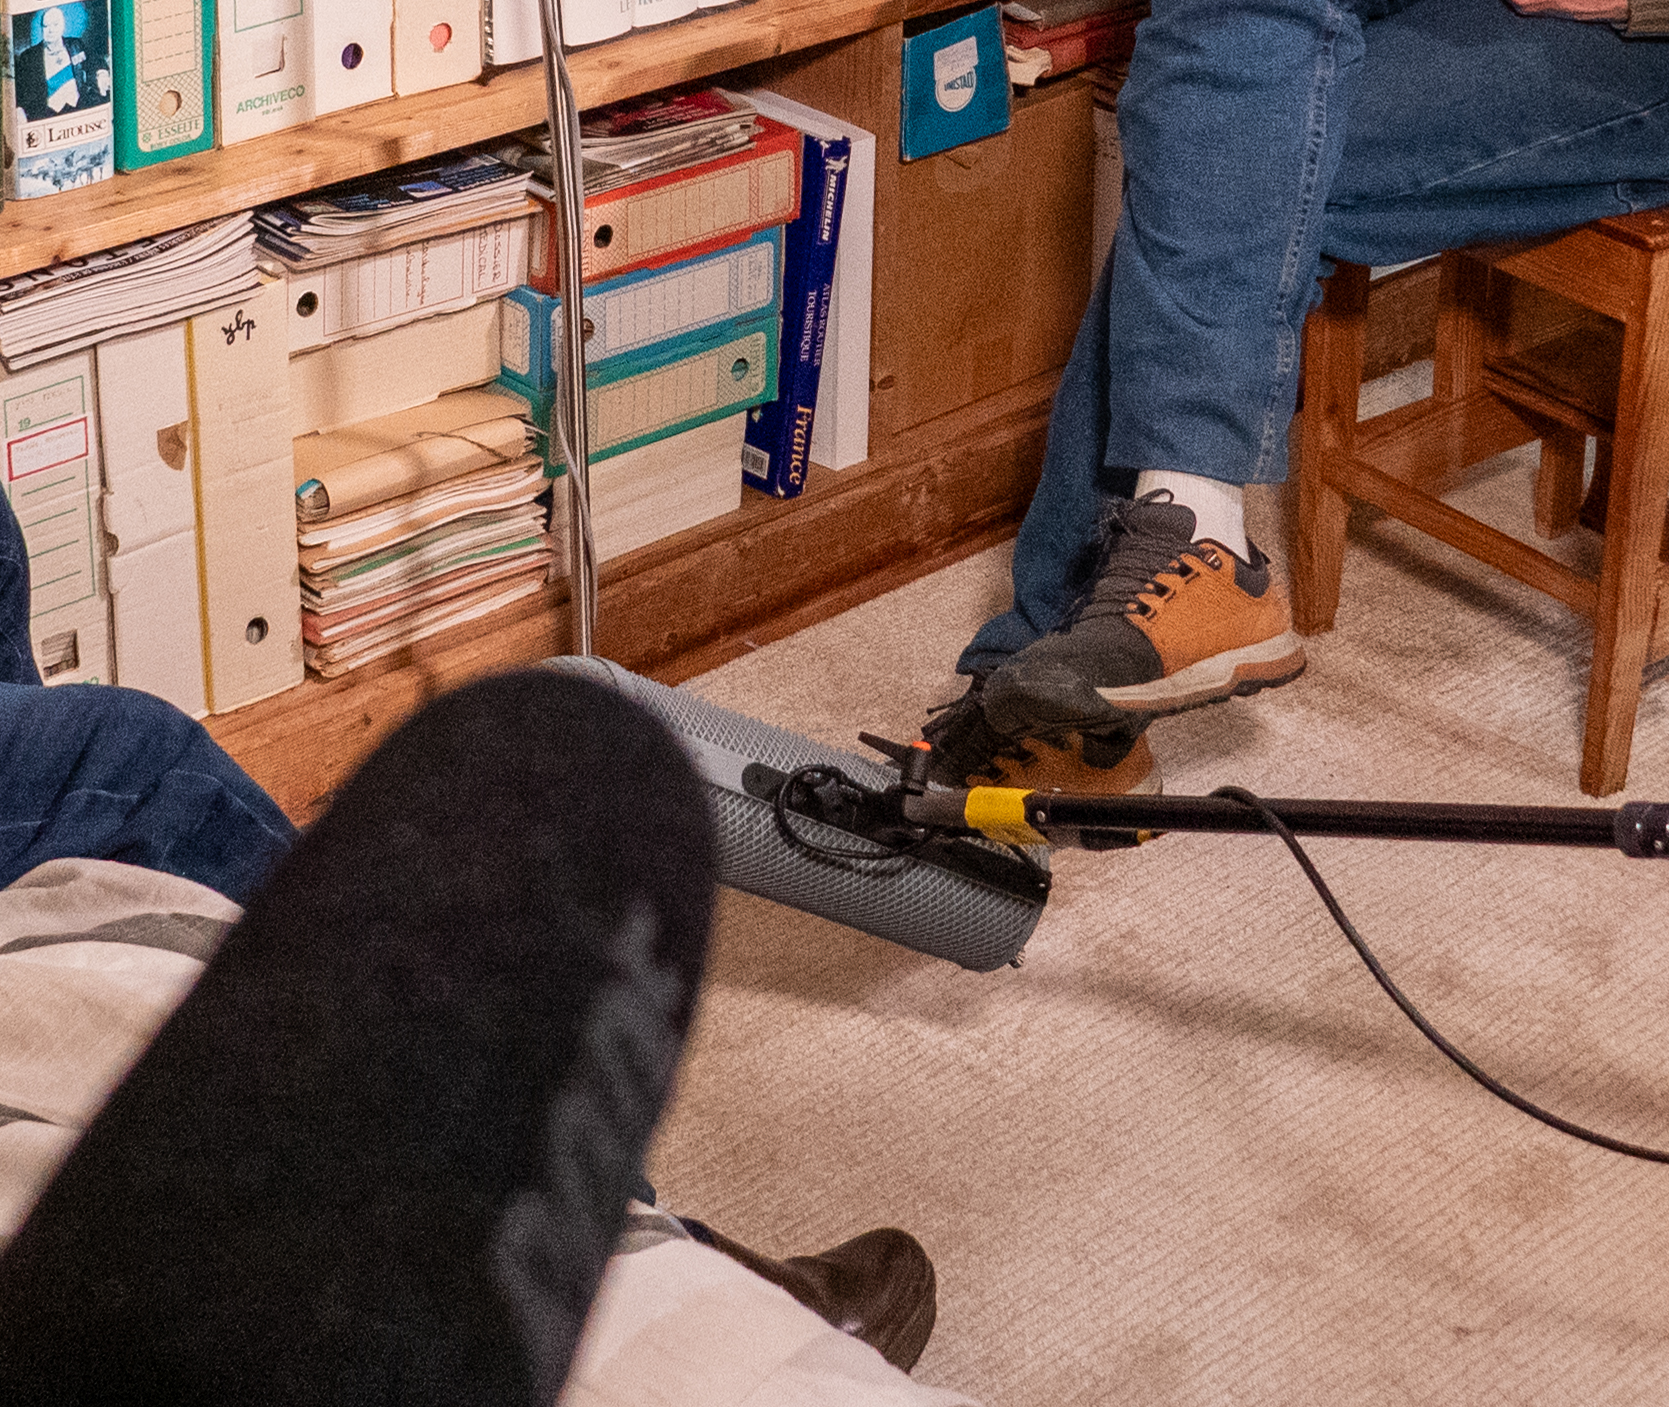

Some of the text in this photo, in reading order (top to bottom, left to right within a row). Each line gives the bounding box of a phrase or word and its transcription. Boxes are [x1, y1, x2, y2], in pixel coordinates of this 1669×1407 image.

[236, 84, 306, 117] ARCHIVECO
[47, 116, 107, 145] Larousse
[157, 118, 202, 141] ESSELTE
[821, 174, 837, 242] MICHELIN
[818, 282, 831, 318] ATLAS
[799, 288, 818, 364] TOURISTIQUE
[18, 416, 32, 430] 19
[788, 404, 814, 487] France
